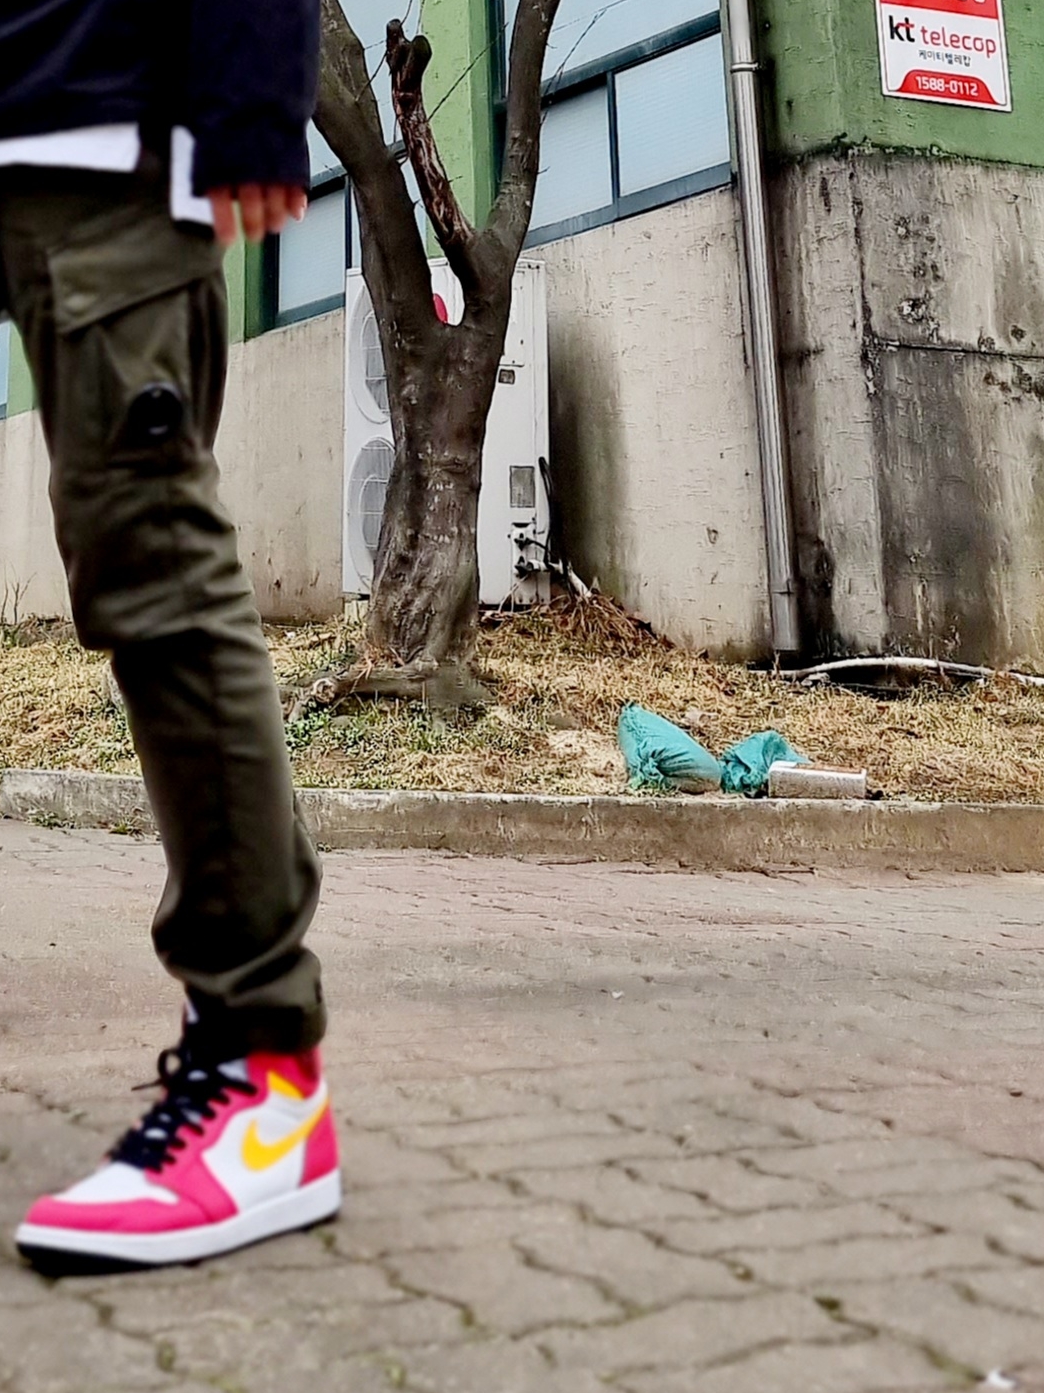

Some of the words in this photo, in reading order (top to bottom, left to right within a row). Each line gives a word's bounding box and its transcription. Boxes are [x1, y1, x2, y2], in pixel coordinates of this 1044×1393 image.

[889, 15, 915, 43] kt
[920, 26, 997, 59] telecop
[915, 75, 979, 97] 1588-0112
